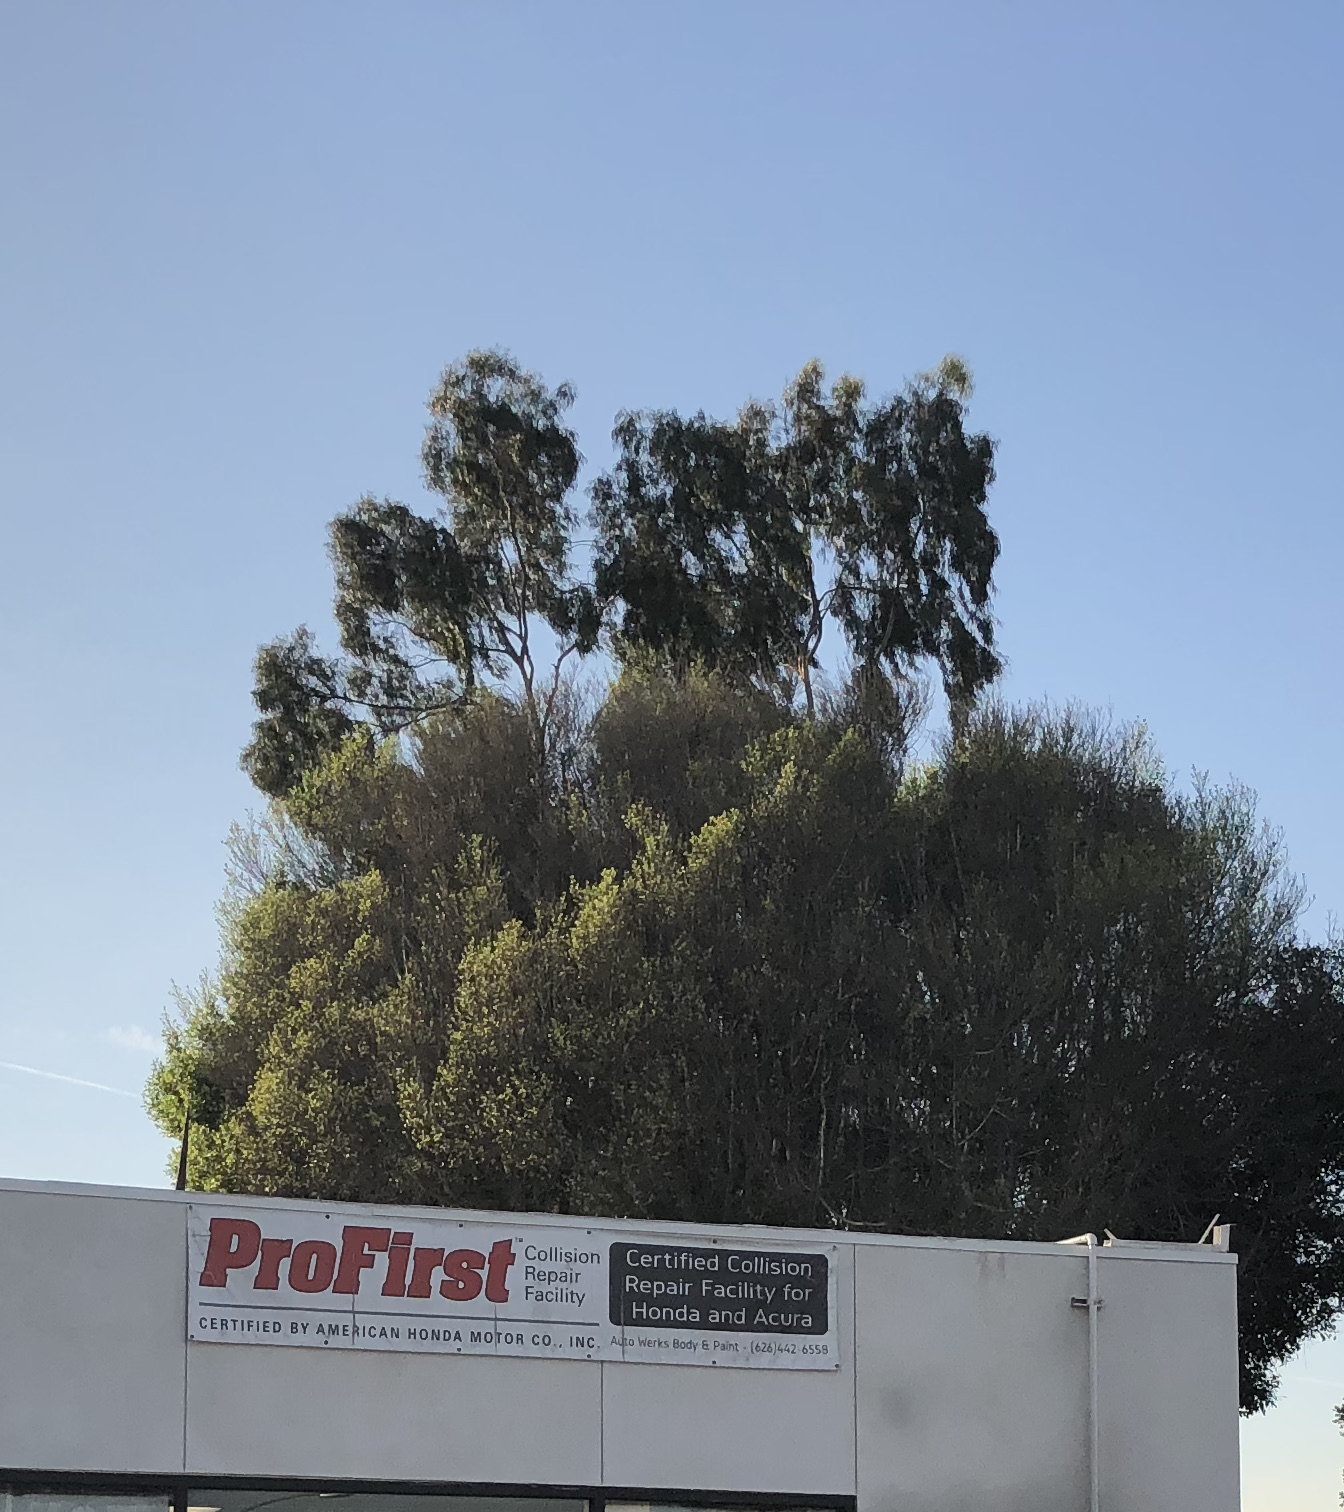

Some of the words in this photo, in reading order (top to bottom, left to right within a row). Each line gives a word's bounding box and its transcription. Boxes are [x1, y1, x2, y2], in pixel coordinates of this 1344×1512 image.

[199, 1218, 516, 1303] ProFirst
[524, 1245, 601, 1264] Collision
[626, 1249, 718, 1272] Certified
[727, 1255, 812, 1277] Collision
[524, 1266, 581, 1285] Repair
[524, 1286, 586, 1307] Facility
[624, 1275, 693, 1297] Repair
[701, 1279, 776, 1303] Facility
[782, 1283, 813, 1301] for
[632, 1301, 700, 1322] Honda
[707, 1306, 746, 1324] and
[753, 1308, 812, 1327] Acura
[199, 1317, 282, 1334] CERTIFIED
[290, 1321, 309, 1335] BY
[316, 1323, 400, 1339] AMERICAN
[408, 1328, 462, 1343] HONDA
[470, 1331, 524, 1345] MOTOR
[569, 1336, 600, 1349] INC.
[610, 1335, 635, 1347] Auto
[638, 1336, 670, 1348] Werks
[673, 1339, 698, 1352] Body
[702, 1340, 710, 1351] &
[713, 1340, 739, 1351] Paint
